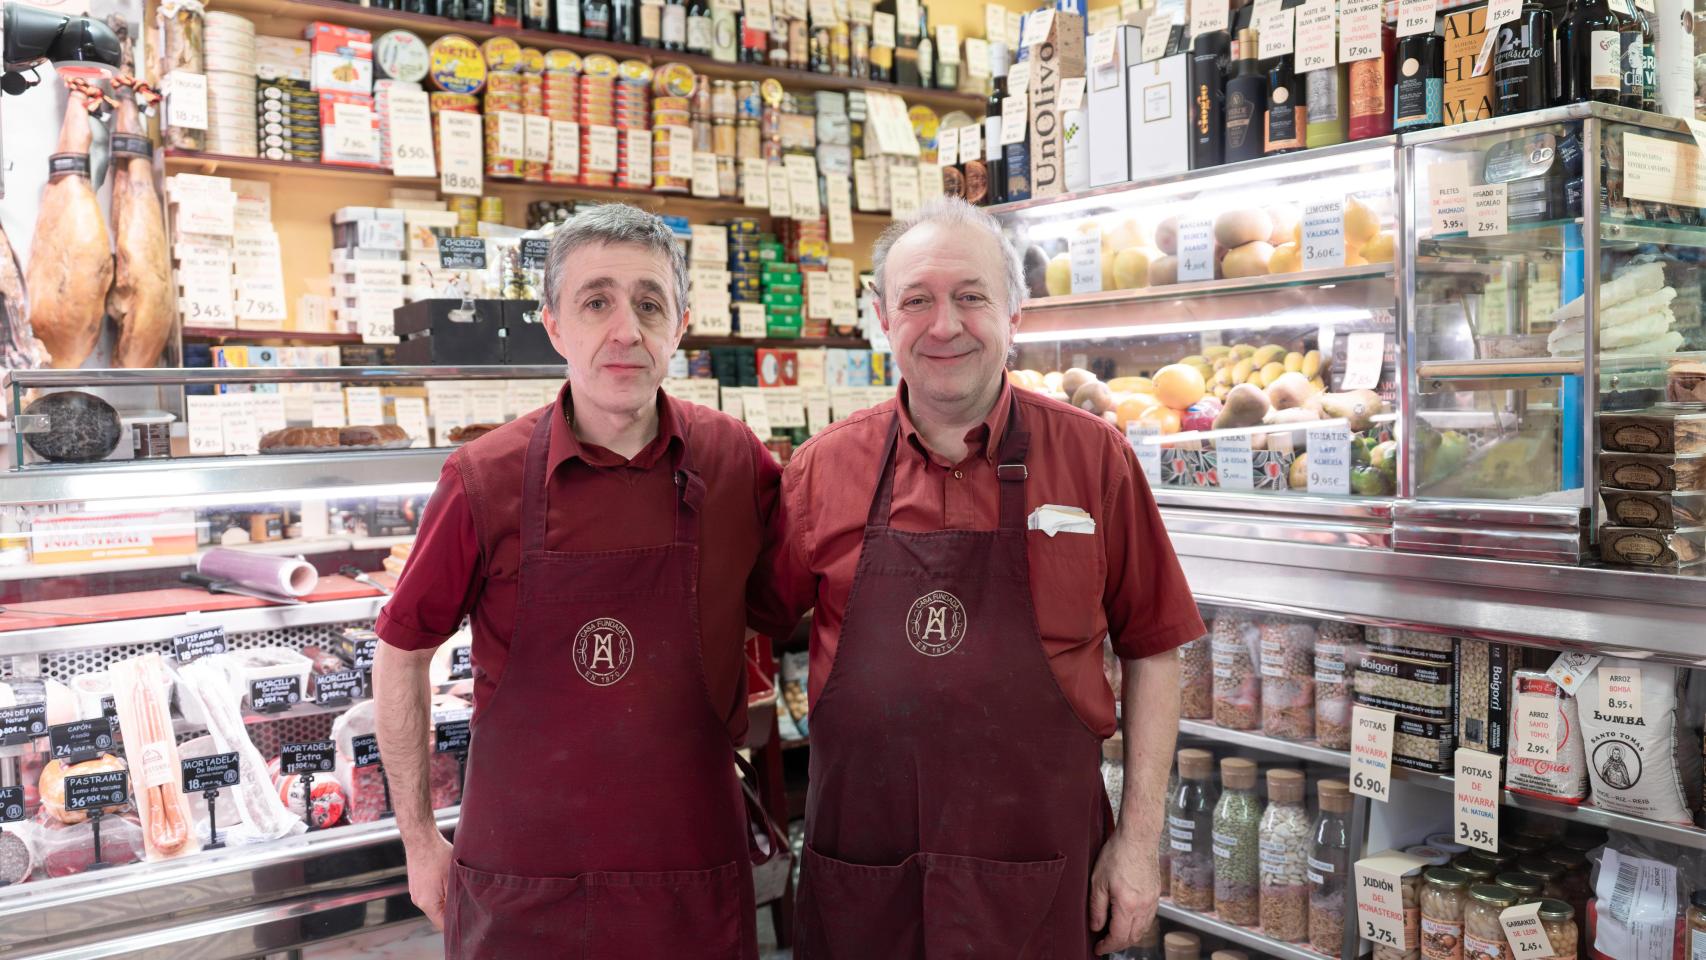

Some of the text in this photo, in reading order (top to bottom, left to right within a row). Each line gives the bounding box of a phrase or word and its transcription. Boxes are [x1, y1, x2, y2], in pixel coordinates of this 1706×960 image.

[1303, 9, 1319, 17] ACEITE
[1360, 4, 1379, 12] VIRGEN
[1035, 42, 1057, 190] UnOlivo
[1439, 188, 1459, 196] FILETES
[1305, 203, 1341, 215] LIMONES
[1476, 200, 1501, 208] BACALAO
[1438, 207, 1465, 215] AHUMADO
[1306, 228, 1340, 238] VALENCIA
[445, 239, 481, 247] CHORIZO
[1308, 432, 1348, 441] TOMATES
[916, 593, 960, 610] CASA FUNDADA
[581, 620, 626, 638] CASA FUNDADA
[175, 629, 223, 645] BUTIFARRAS
[916, 641, 928, 651] EN
[1360, 658, 1399, 675] Baigorri
[317, 671, 362, 684] MORCILLA
[584, 670, 620, 684] EN 1870
[1609, 675, 1631, 683] ARROZ
[255, 677, 296, 689] MORCILLA
[332, 680, 357, 691] Burgos
[1491, 665, 1503, 711] Baigorri
[1609, 685, 1631, 693] BOMBA
[25, 707, 45, 715] PAVO
[1382, 699, 1402, 708] NAVARRA
[1402, 703, 1420, 711] BLANCAS
[1424, 707, 1443, 716] VERDES
[1528, 711, 1549, 719] ARROZ
[67, 723, 92, 733] CAPÓN
[1359, 718, 1387, 732] POTXAS
[1528, 721, 1549, 729] SANTO
[1367, 734, 1377, 743] DE
[1591, 731, 1645, 752] SANTO TOMAS
[282, 742, 335, 753] MORTADELA
[1355, 744, 1388, 759] NAVARRA
[183, 755, 239, 770] MORTADELA
[295, 753, 322, 762] Extra
[1357, 756, 1387, 769] AL NATURAL
[1415, 761, 1433, 769] VERDES
[1461, 765, 1493, 779] POTXAS
[69, 773, 123, 787] PASTRAMI
[72, 787, 89, 795] Lomo
[1471, 781, 1482, 791] DE
[1458, 793, 1496, 809] NAVARRA
[1470, 809, 1495, 819] NATURAL
[1362, 876, 1394, 892] JUDIÓN
[1372, 893, 1385, 904] DEL
[1358, 902, 1402, 922] MONASTERIO
[1506, 918, 1537, 928] GARBANZO
